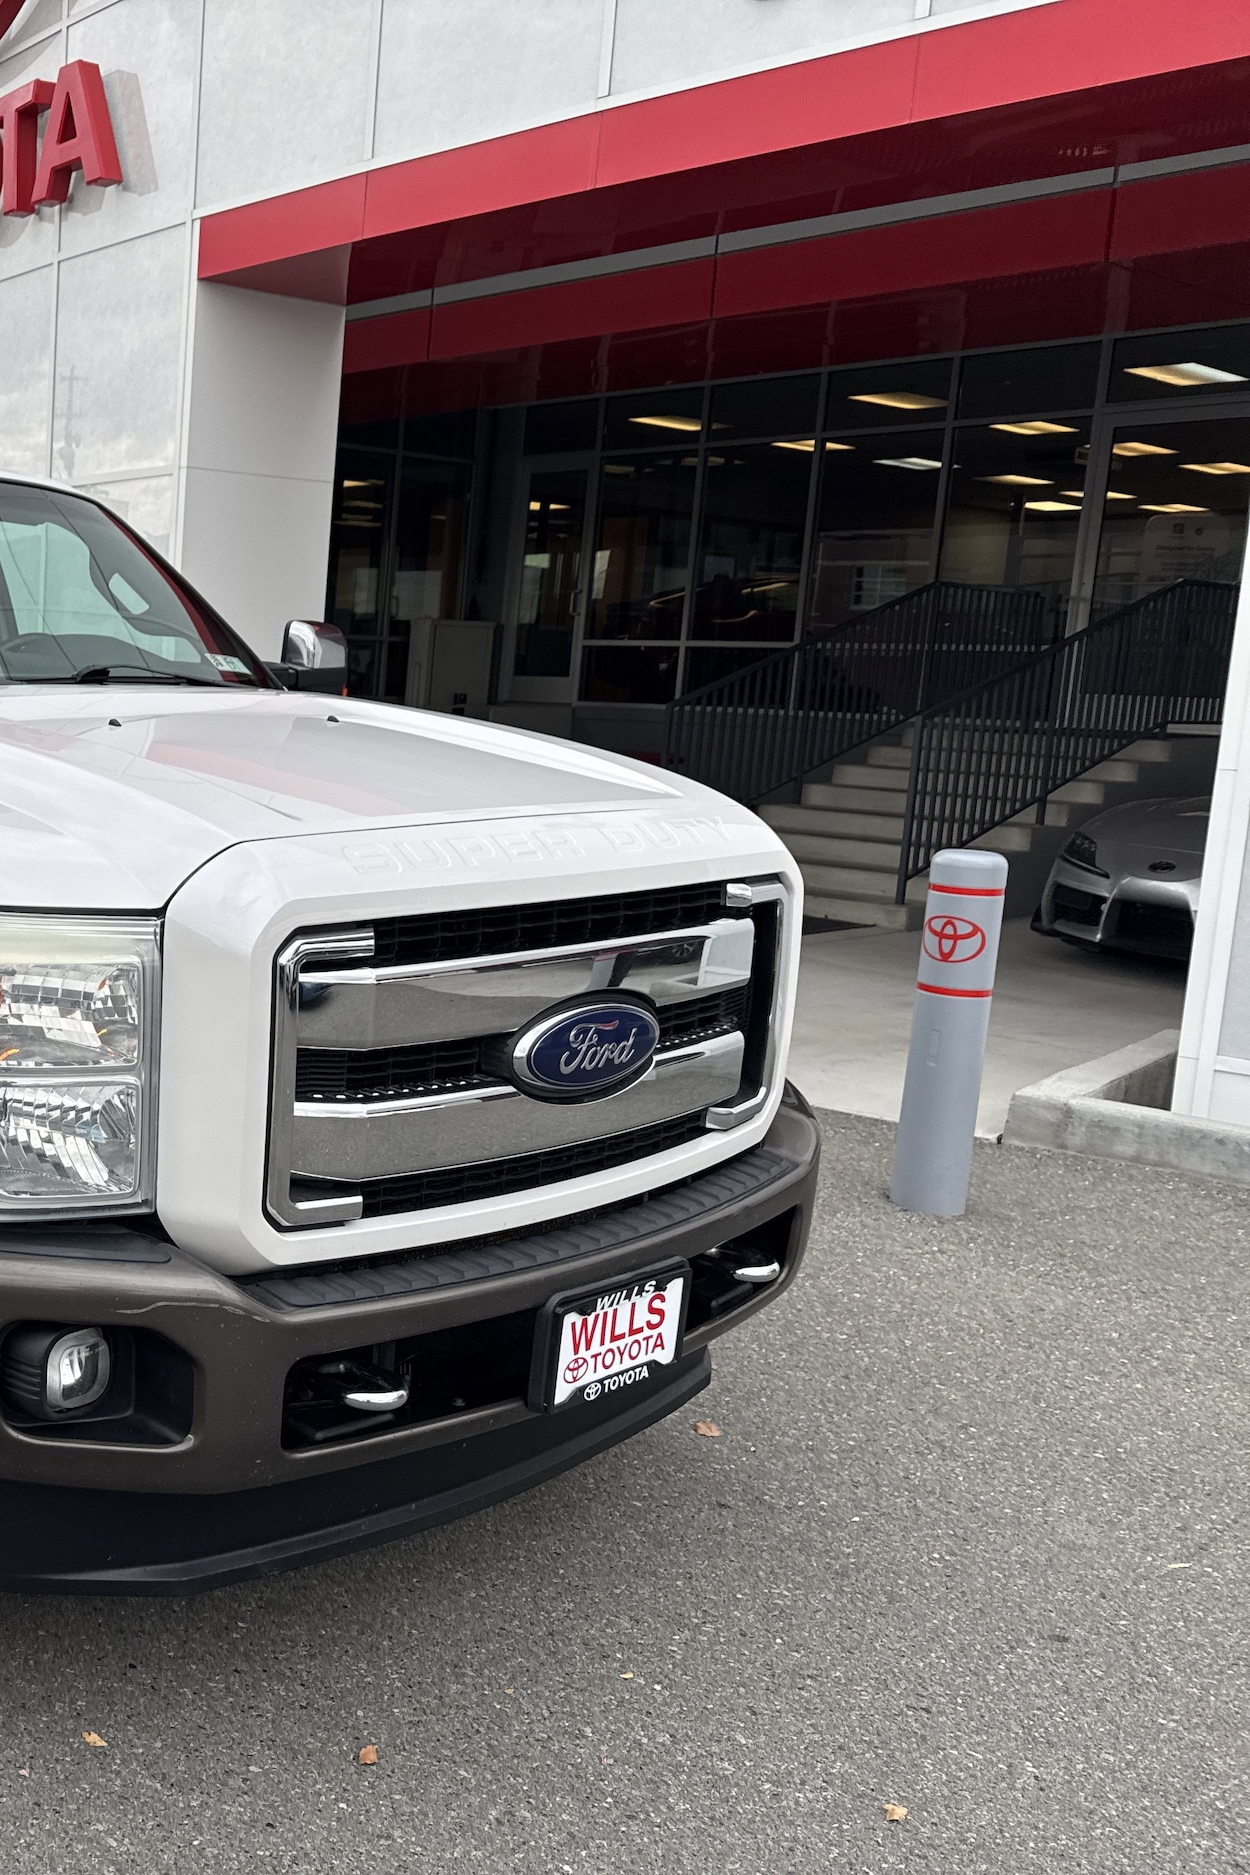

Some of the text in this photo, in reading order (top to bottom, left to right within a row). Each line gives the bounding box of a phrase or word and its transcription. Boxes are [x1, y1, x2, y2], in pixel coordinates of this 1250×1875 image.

[341, 816, 732, 874] SUPER DUTY
[560, 1020, 637, 1075] Ford
[596, 1280, 657, 1311] WILLS
[571, 1293, 667, 1356] WILLS
[591, 1332, 666, 1374] TOYOTA
[603, 1365, 649, 1393] TOYOTA
